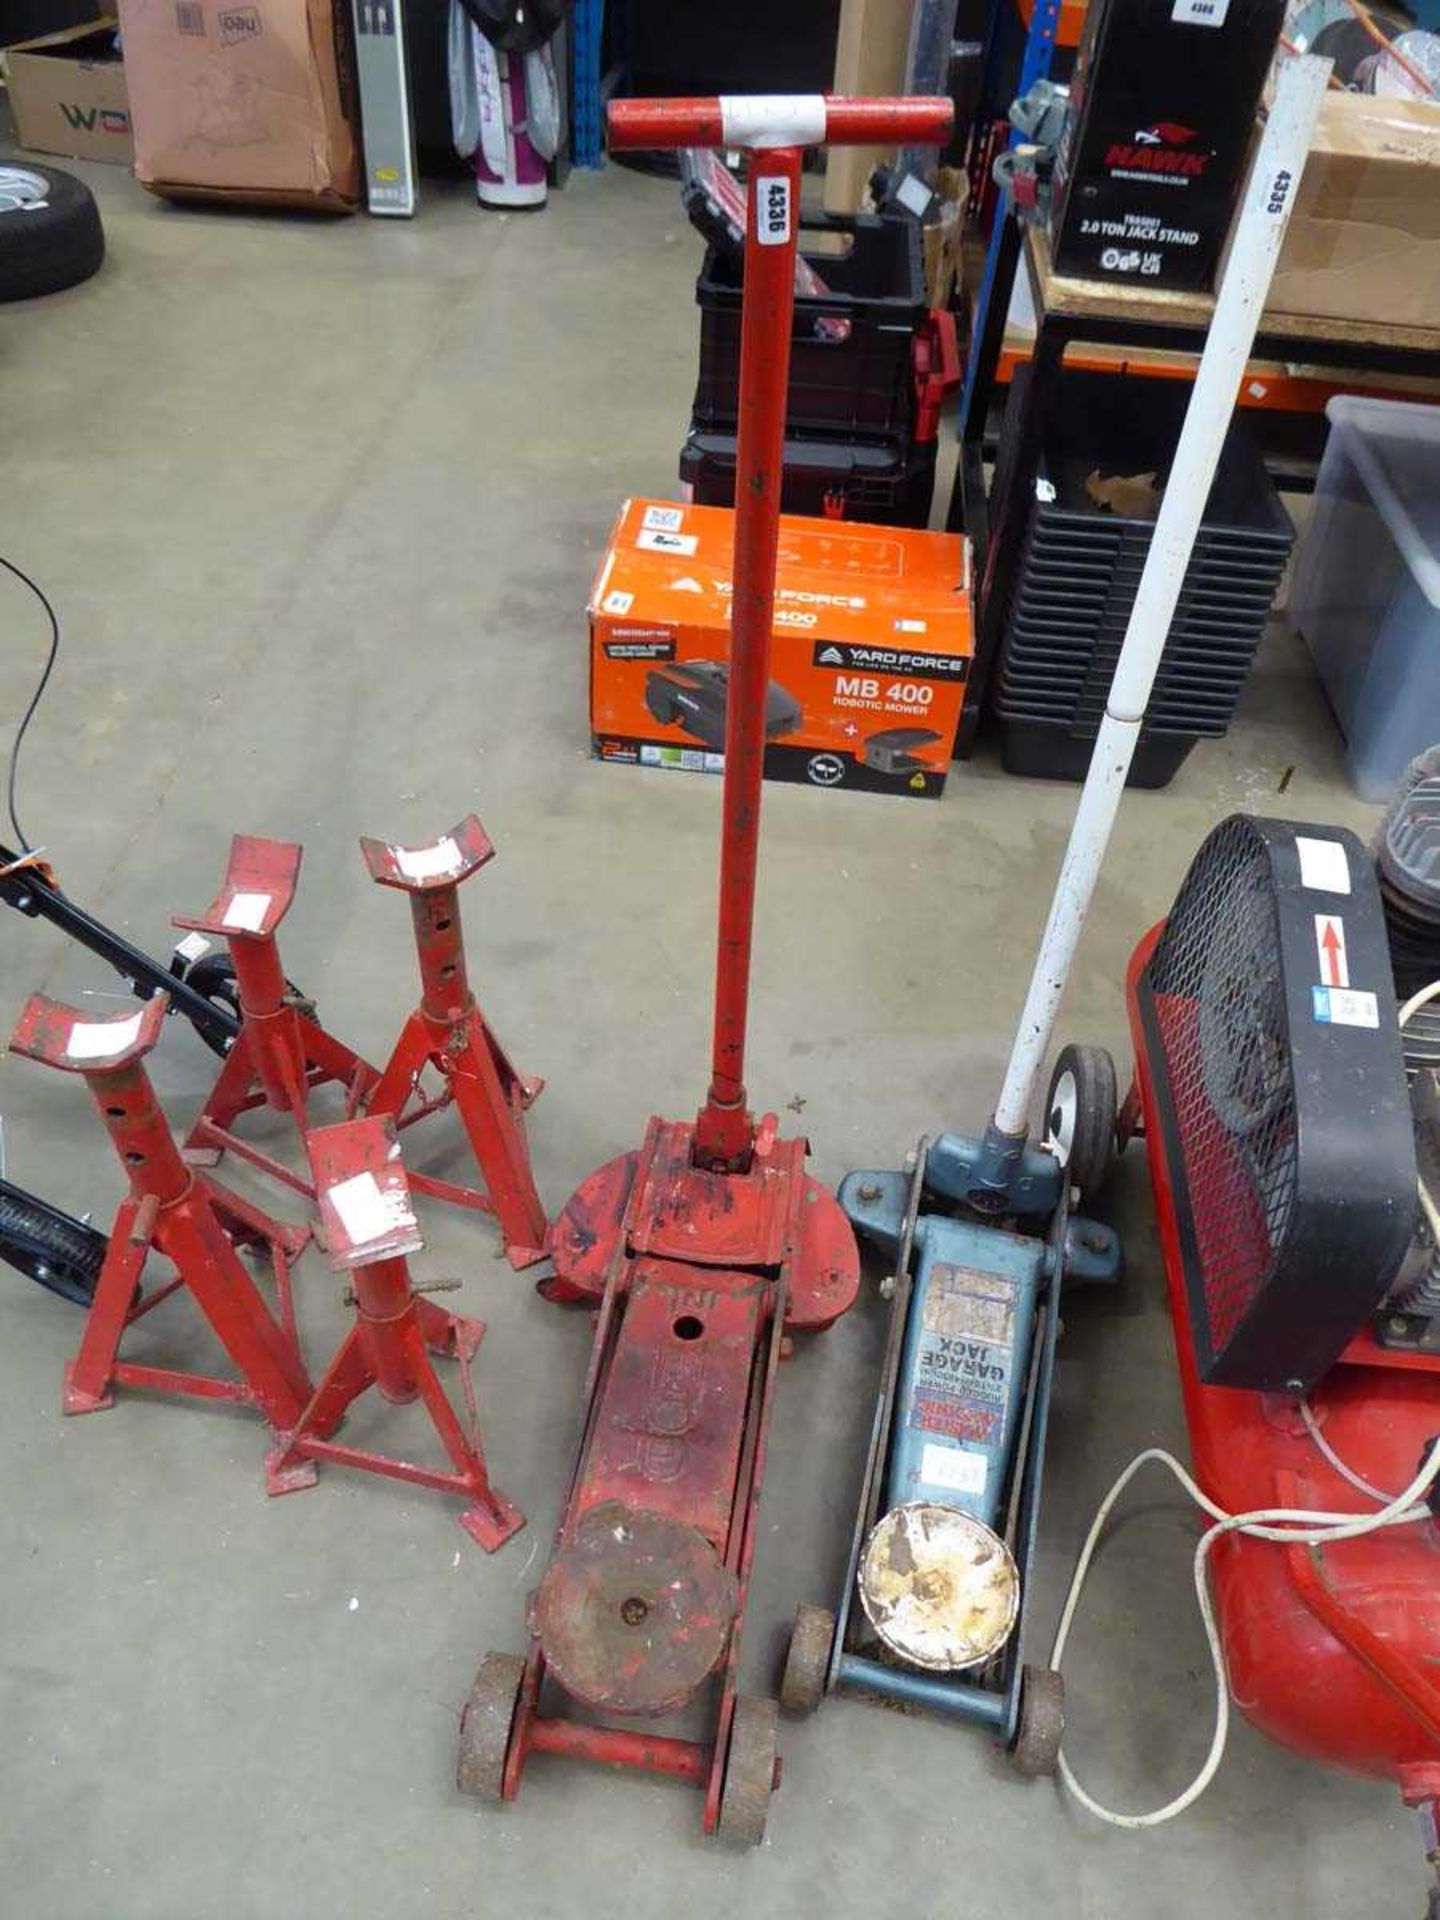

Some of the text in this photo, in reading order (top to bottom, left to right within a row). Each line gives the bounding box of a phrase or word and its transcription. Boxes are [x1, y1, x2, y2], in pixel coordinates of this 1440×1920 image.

[1104, 145, 1209, 175] HAWK
[1267, 170, 1292, 214] 4335
[768, 184, 786, 232] 4336
[1080, 219, 1200, 246] 2.0 TON JACK STAND
[780, 589, 866, 608] FORCE
[850, 648, 962, 672] YARD FORCE
[835, 676, 934, 705] MB 400
[832, 695, 928, 716] ROBOTIC MOWER
[939, 1337, 988, 1362] JACK
[921, 1351, 1005, 1381] GARAGE
